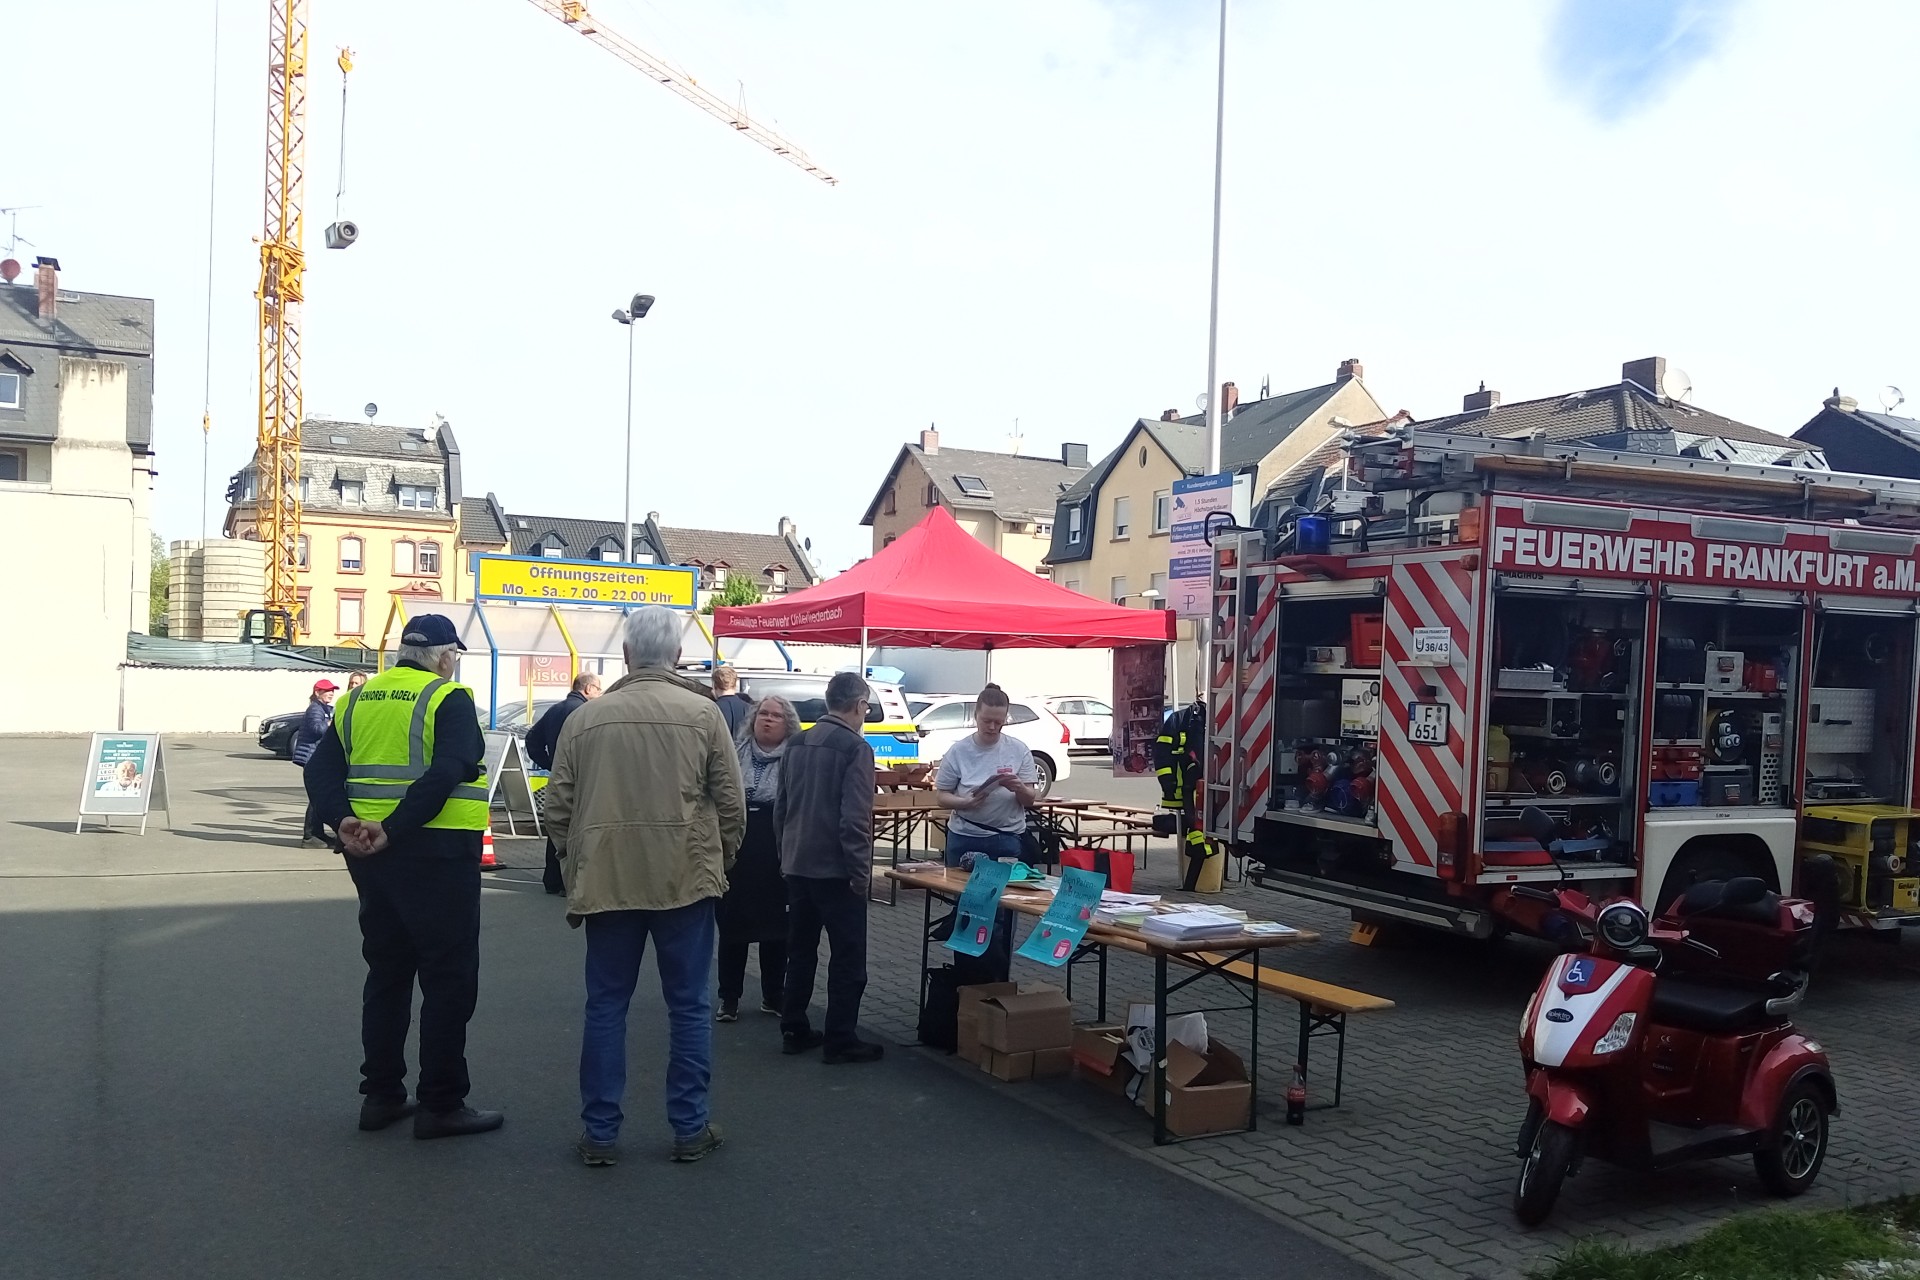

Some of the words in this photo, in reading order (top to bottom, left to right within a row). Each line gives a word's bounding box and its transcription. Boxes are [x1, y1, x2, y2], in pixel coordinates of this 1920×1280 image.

[1494, 527, 1695, 577] FEUERWEHR
[1706, 544, 1869, 588] FRANKFURT
[529, 564, 650, 585] Öffnungszeiten:
[502, 583, 527, 595] Mo.
[571, 587, 598, 599] 7.00
[611, 590, 646, 601] 22.00
[650, 592, 673, 603] Uhr
[758, 613, 790, 628] Feuerwehr
[1425, 643, 1449, 652] 36/43
[525, 668, 568, 682] Bisko
[359, 690, 387, 701] SENIOREN
[390, 690, 418, 702] RADELN
[1424, 707, 1433, 722] F
[1415, 723, 1438, 740] 651
[881, 745, 892, 753] 110
